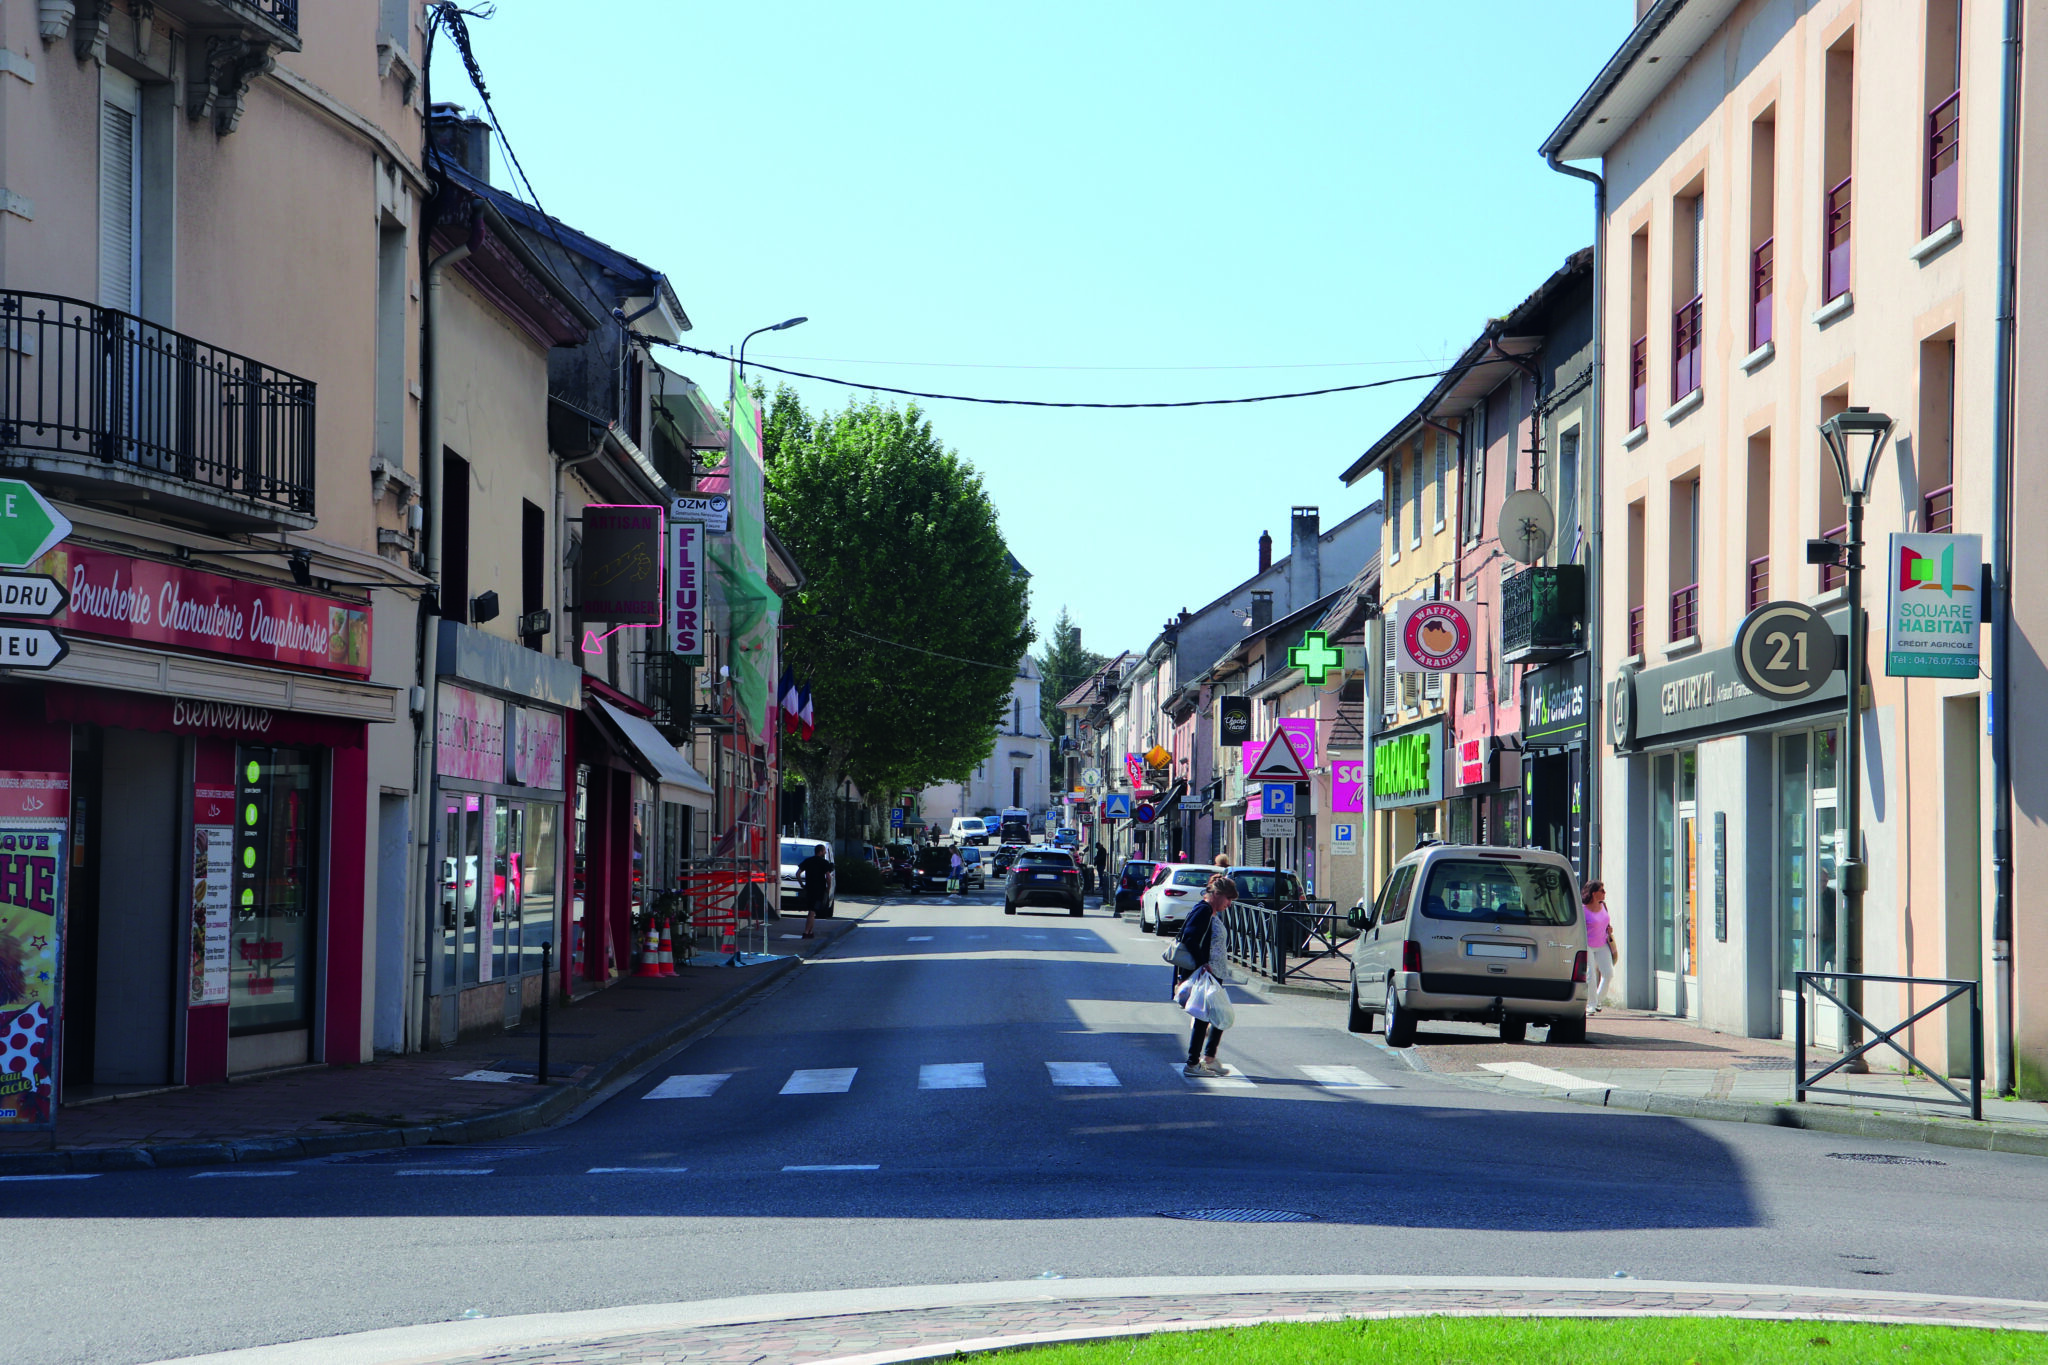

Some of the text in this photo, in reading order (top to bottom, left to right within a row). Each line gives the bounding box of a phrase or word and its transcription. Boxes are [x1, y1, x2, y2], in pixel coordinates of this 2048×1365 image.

[677, 498, 706, 510] OZM
[589, 516, 651, 530] ARTISAN
[676, 528, 697, 651] FLEURS
[70, 563, 327, 660] Boucherie Charcuterie Dauphinoise
[584, 601, 655, 614] BOULANGER
[1416, 607, 1459, 621] WAFFLE
[1900, 603, 1973, 618] SQUARE
[1898, 618, 1974, 634] HABITAT
[1930, 641, 1973, 649] AGRICOLE
[1414, 648, 1463, 667] PARADISE
[1661, 674, 1704, 715] CENTURY
[173, 697, 273, 732] Bienvenue
[1374, 733, 1430, 797] PHARMACIE
[22, 795, 44, 812] حلال
